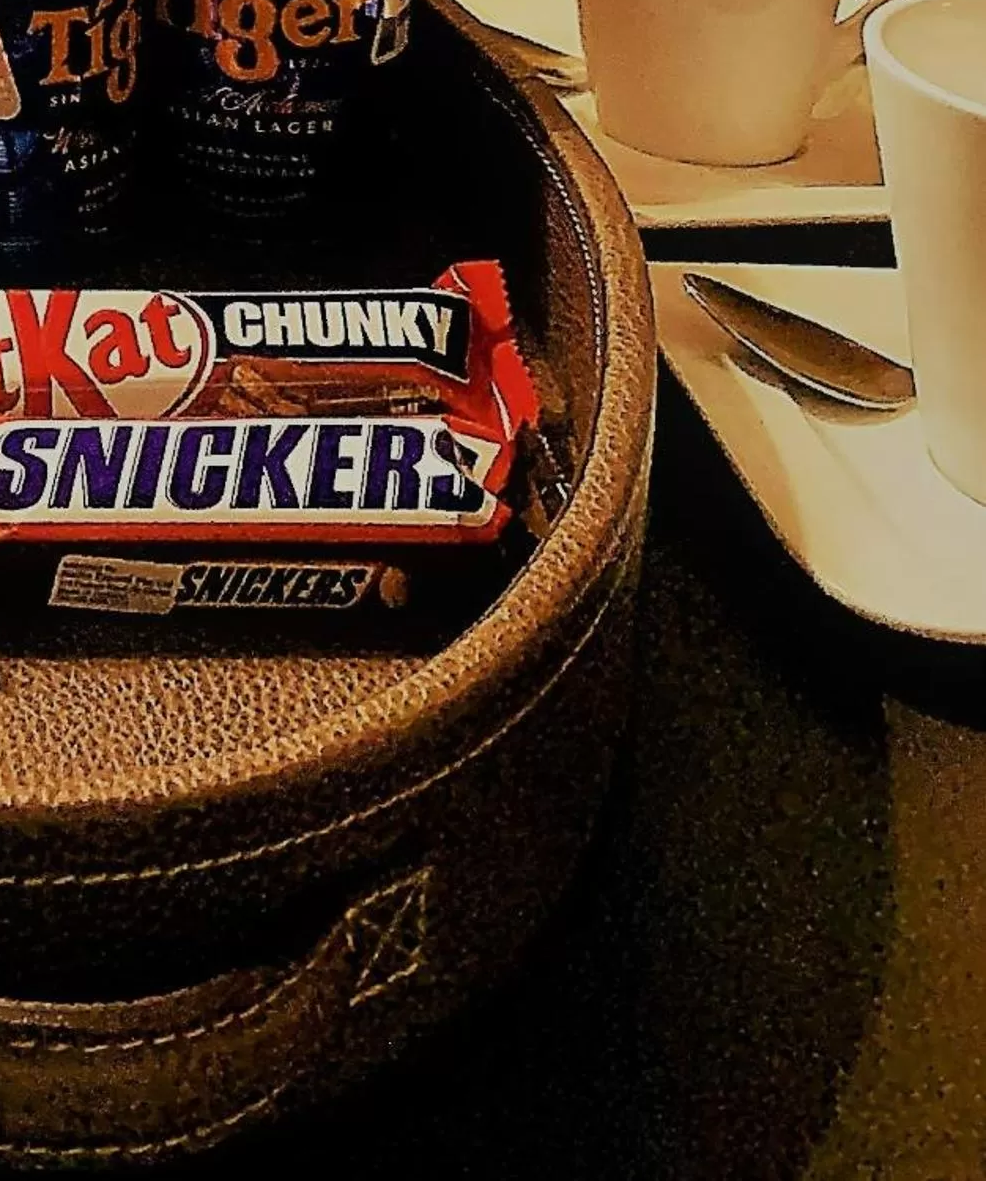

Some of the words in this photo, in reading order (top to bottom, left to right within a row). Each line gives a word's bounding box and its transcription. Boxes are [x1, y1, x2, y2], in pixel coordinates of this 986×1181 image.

[254, 117, 335, 135] LAGER
[223, 300, 453, 356] CHUNKY
[177, 566, 365, 604] SNICKERS
